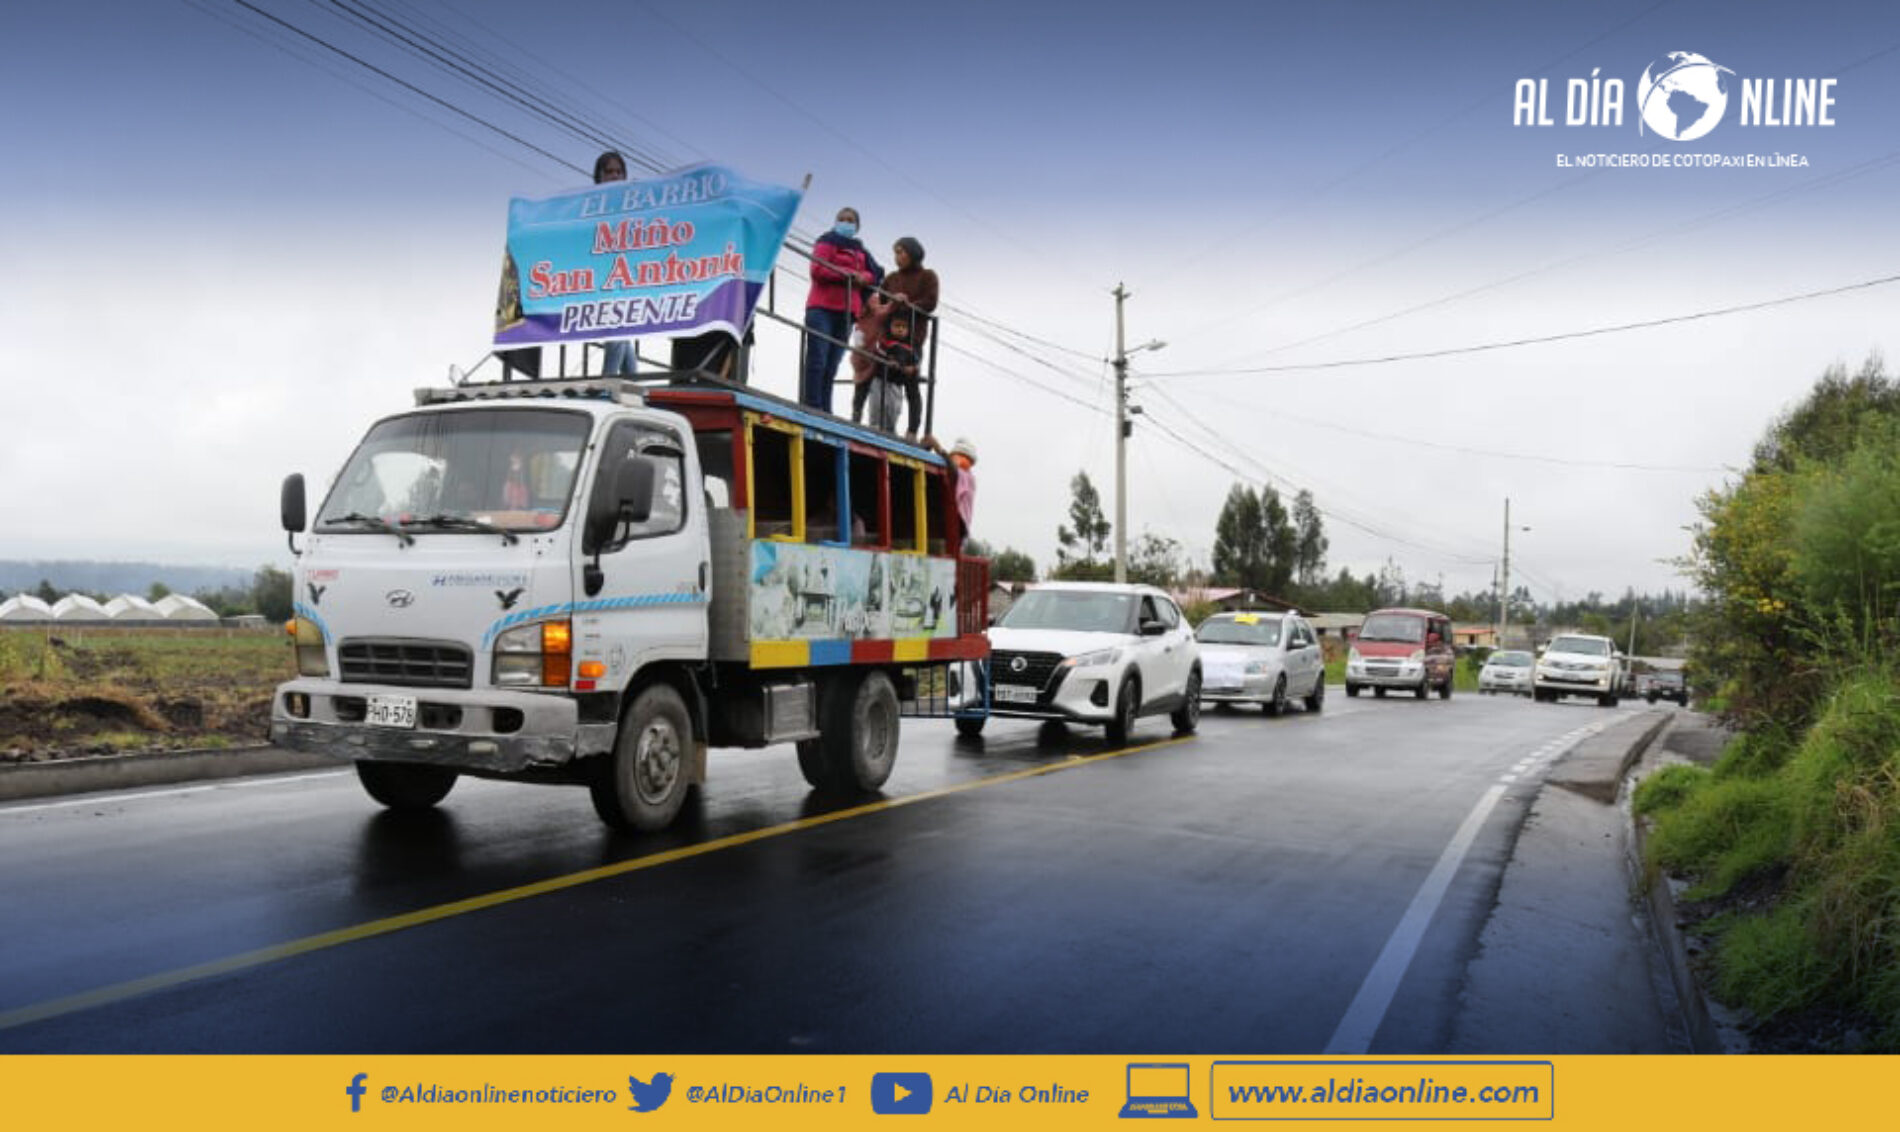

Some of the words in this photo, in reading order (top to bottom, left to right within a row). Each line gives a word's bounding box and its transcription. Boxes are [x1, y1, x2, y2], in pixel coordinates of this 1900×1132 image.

[583, 199, 610, 217] EL
[623, 173, 727, 211] BARRIO
[592, 217, 695, 254] Miño
[529, 261, 594, 297] San
[561, 293, 697, 332] PRESENTE
